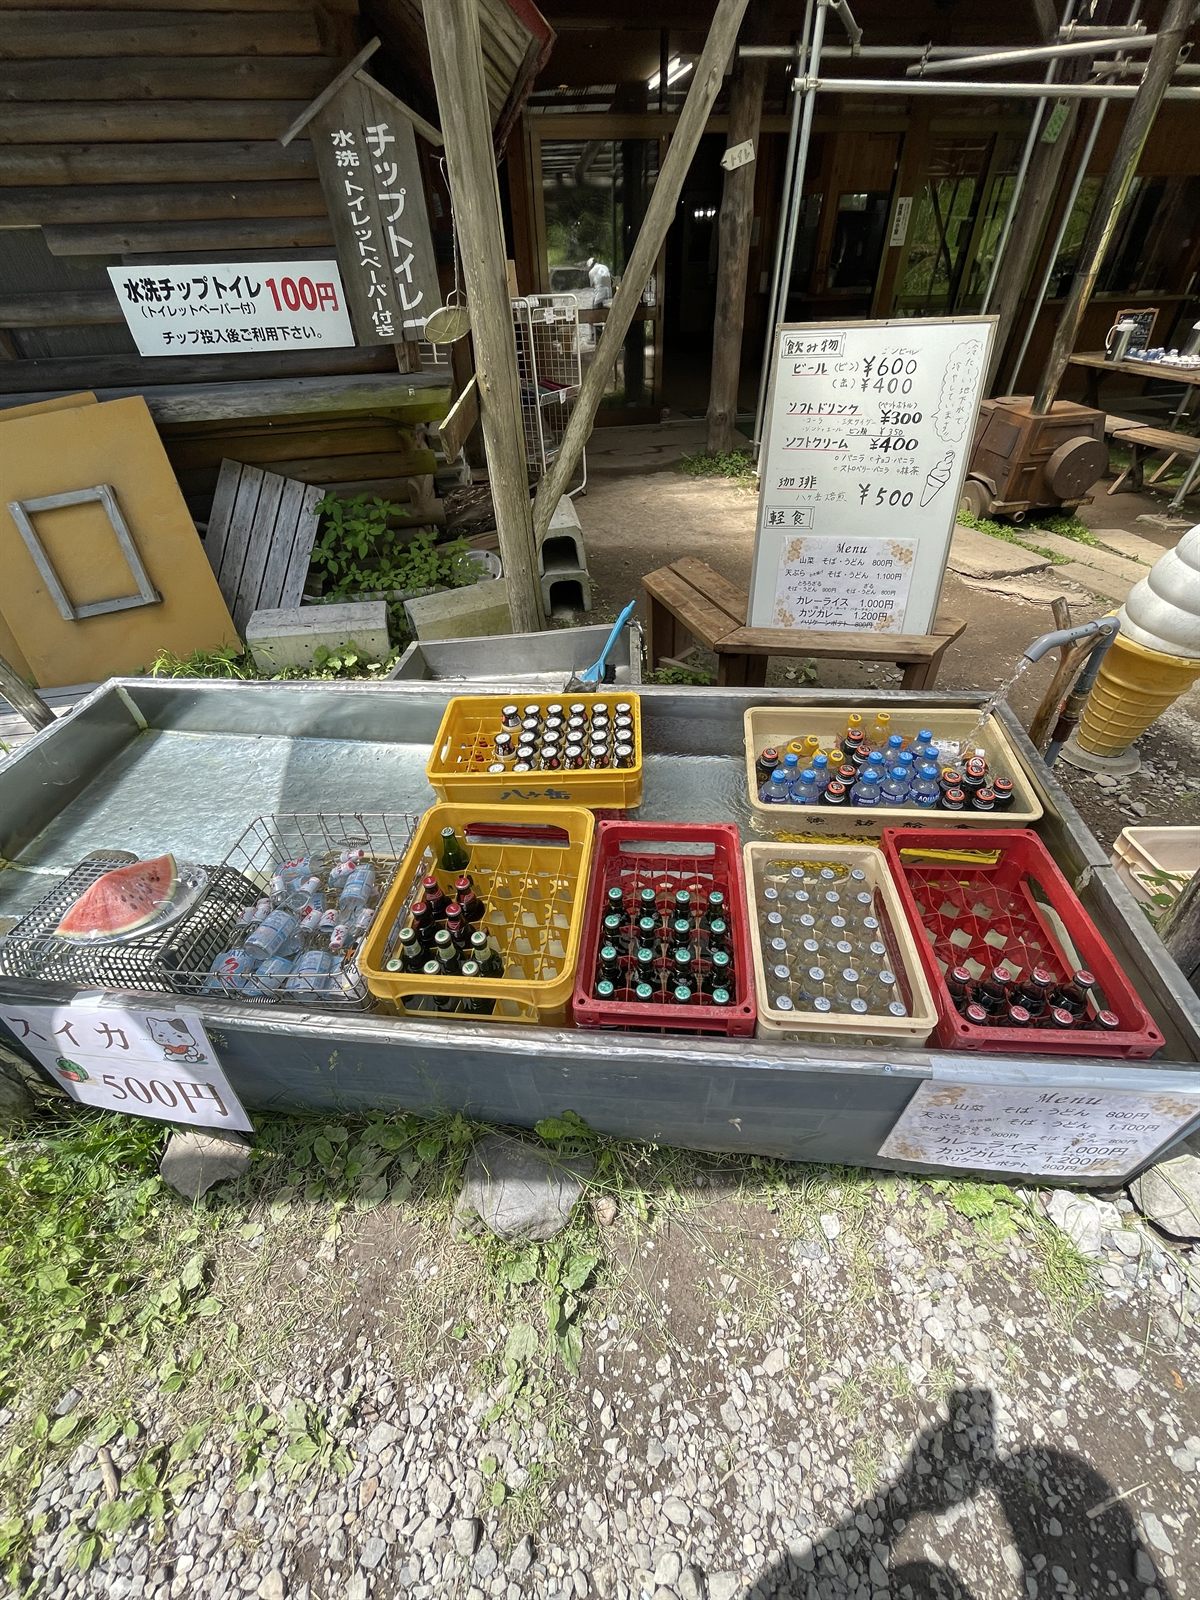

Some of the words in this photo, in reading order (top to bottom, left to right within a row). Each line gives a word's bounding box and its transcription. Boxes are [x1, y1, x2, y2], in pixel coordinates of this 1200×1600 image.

[366, 123, 423, 310] チップトイレ
[331, 130, 395, 337] 水洗・トイレットペーパー付き
[123, 275, 261, 303] 水洗チップトイレ
[265, 276, 339, 311] 100円
[141, 302, 256, 318] （トイレットペーパー付）
[162, 326, 322, 345] チップ投入後ご利用下さい。
[787, 340, 839, 354] 飲み物
[793, 363, 828, 374] ビール
[863, 356, 917, 377] ¥600
[861, 378, 912, 394] ¥400
[789, 402, 858, 415] ソフトドリンク
[880, 409, 922, 425] ¥300
[786, 437, 848, 449] ソフトクリーム
[869, 437, 919, 453] ¥400
[778, 476, 817, 488] 珈琲
[859, 484, 913, 507] ¥500
[768, 510, 805, 525] 軽食
[837, 542, 868, 554] Menu
[799, 557, 814, 565] 山菜
[822, 557, 865, 566] そば・うどん
[871, 559, 893, 567] 800円
[827, 570, 869, 579] そば・うどん
[796, 596, 849, 607] カレーライス
[859, 599, 894, 609] 1.000円
[799, 608, 843, 618] カツカレー
[854, 611, 888, 621] 1.200円
[7, 1016, 130, 1050] スイカ
[103, 1074, 229, 1117] 500円
[1036, 1093, 1102, 1105] Menu
[1002, 1106, 1090, 1117] そば・うどん
[1105, 1112, 1150, 1120] 800円
[1008, 1118, 1092, 1129] そば・うどん
[936, 1136, 1038, 1151] カレーライス
[1063, 1146, 1128, 1156] 1.000円
[936, 1147, 1022, 1159] カツカレー
